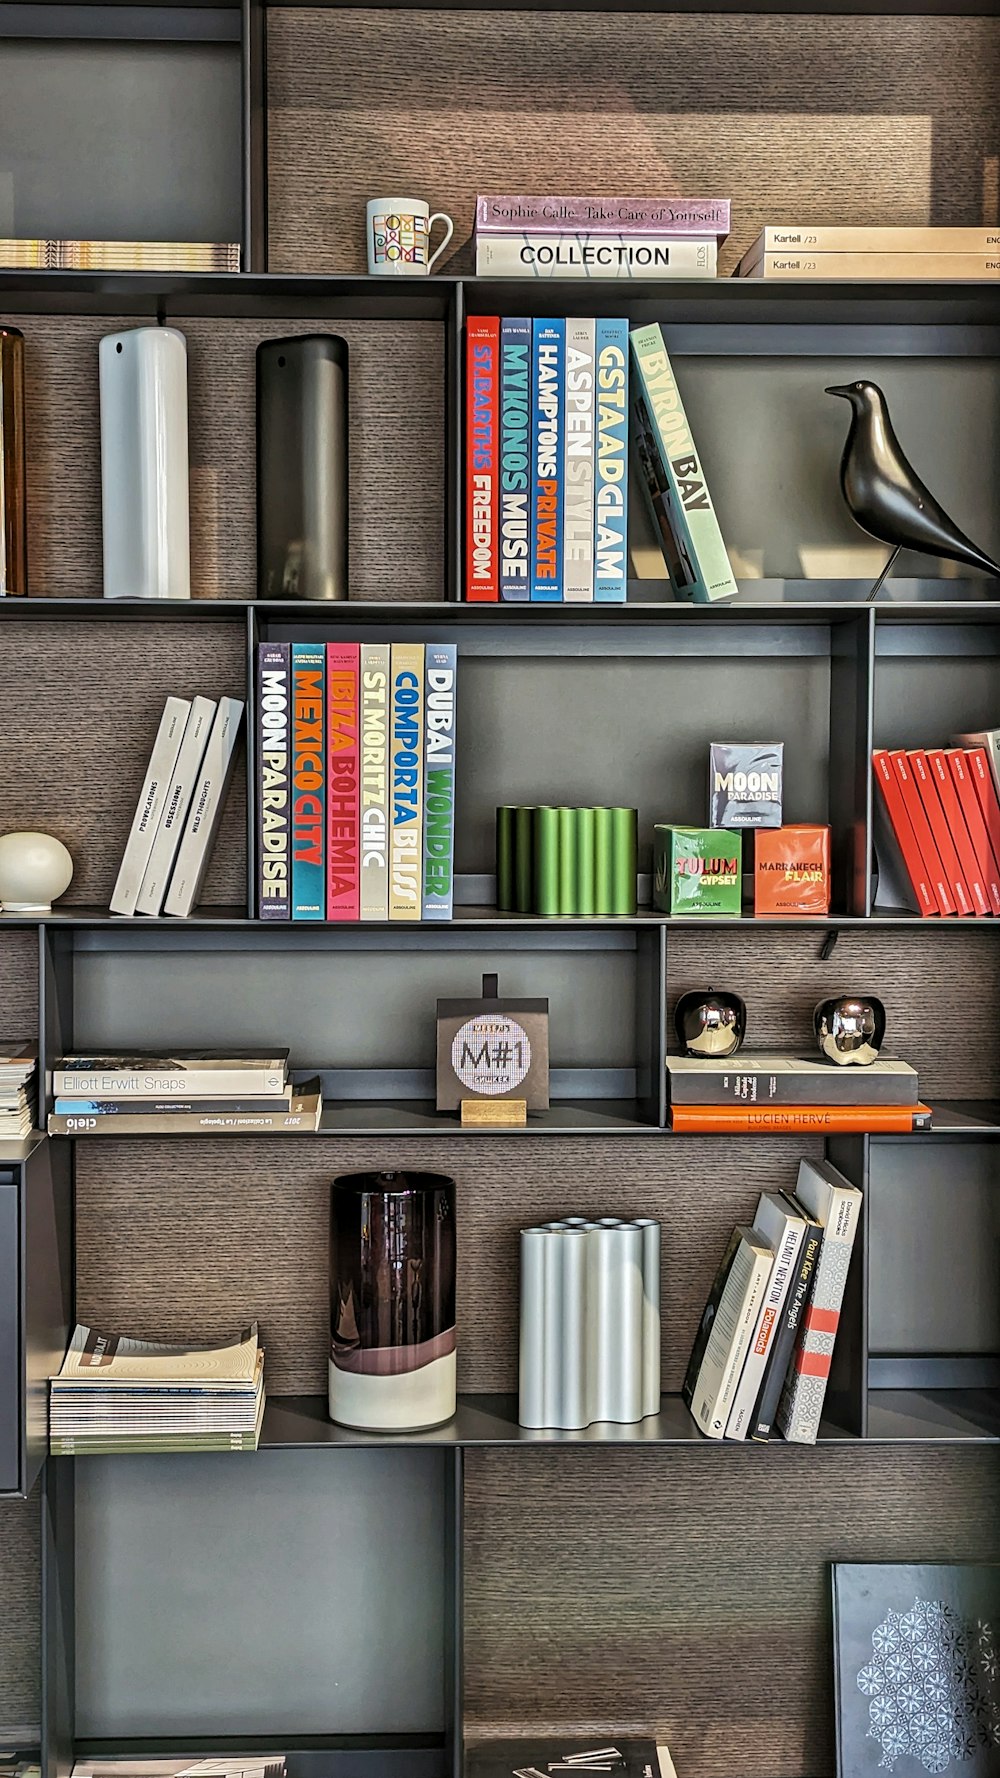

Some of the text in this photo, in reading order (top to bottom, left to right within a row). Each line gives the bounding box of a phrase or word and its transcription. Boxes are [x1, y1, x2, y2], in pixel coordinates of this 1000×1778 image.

[492, 205, 538, 220] Sophie
[542, 206, 575, 218] Calle
[584, 207, 614, 220] Take
[618, 208, 648, 220] Care
[652, 209, 665, 220] of
[669, 209, 722, 222] Yourself
[774, 234, 800, 243] Kartell
[520, 246, 670, 266] COLLECTION
[697, 246, 706, 267] FLOS
[773, 260, 800, 270] Kartell
[640, 350, 710, 513] BYRON BAY
[502, 344, 529, 578] MYKONOS MUSE
[536, 344, 559, 579] HAMPTONS PRIVATE
[566, 346, 592, 562] ASPEN STYLE
[472, 474, 492, 579] FREEDOM
[331, 670, 356, 753] IBIZA
[294, 670, 323, 791] MEXICO
[394, 671, 419, 826] COMPORTA
[880, 758, 890, 780] SELECTED
[897, 758, 907, 780] SELECTED
[916, 758, 926, 780] SELECTED
[935, 758, 946, 780] SELECTED
[954, 757, 964, 780] SELECTED
[976, 756, 985, 779] SELECTED
[425, 669, 454, 898] DUBAI WONDER
[714, 772, 778, 792] MOON
[139, 781, 158, 832] PROVOCATIONS
[165, 785, 183, 829] OBSESSIONS
[192, 780, 210, 834] WILD THOUGHTS
[728, 792, 778, 801] PARADISE
[294, 794, 322, 865] CITY
[331, 756, 356, 898] BOHEMIA
[362, 807, 386, 868] CHIC
[392, 829, 418, 900] BLISS
[676, 858, 738, 876] TULUM
[759, 862, 823, 871] MARRAKECH
[785, 871, 823, 882] FLAIR
[700, 875, 737, 886] GYPSET
[461, 1041, 522, 1069] M#1
[63, 1076, 186, 1091] Elliott Erwitt Snaps
[66, 1118, 97, 1131] cielo
[748, 1112, 830, 1124] LUCIEN HERVÉ
[836, 1201, 846, 1235] scrapbooks
[769, 1230, 798, 1304] HELMUT NEWTON
[800, 1238, 818, 1280] Paul Klee
[787, 1282, 807, 1330] The Angels
[755, 1309, 775, 1353] Polaroids
[735, 1409, 745, 1432] TASCHEN
